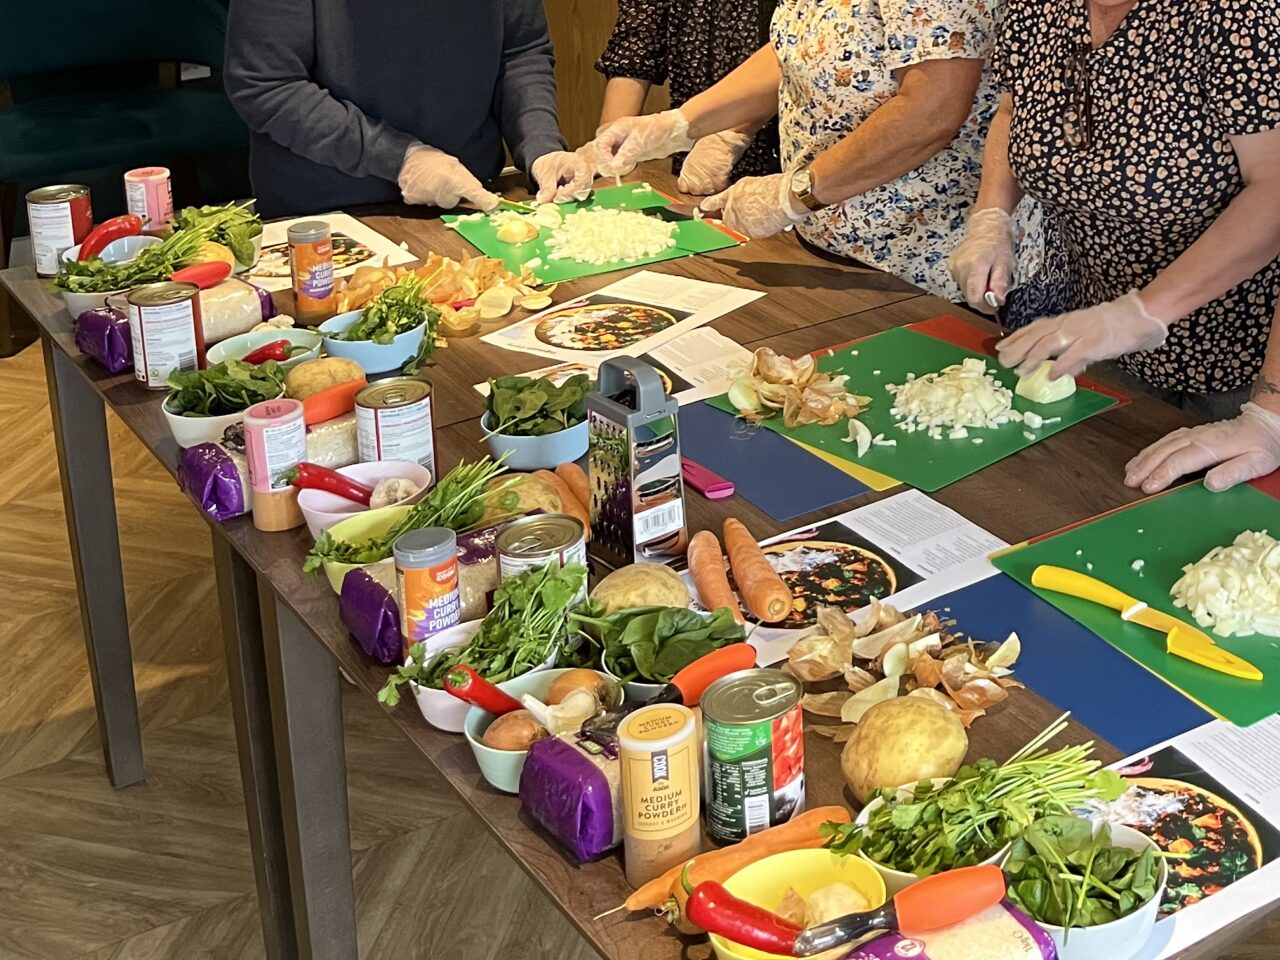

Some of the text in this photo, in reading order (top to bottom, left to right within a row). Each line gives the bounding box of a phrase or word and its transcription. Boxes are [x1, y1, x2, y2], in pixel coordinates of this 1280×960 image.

[653, 755, 667, 778] COOK
[652, 784, 670, 792] ASDA
[640, 789, 683, 804] MEDIUM
[638, 805, 681, 820] POWDER
[644, 799, 679, 812] CURRY
